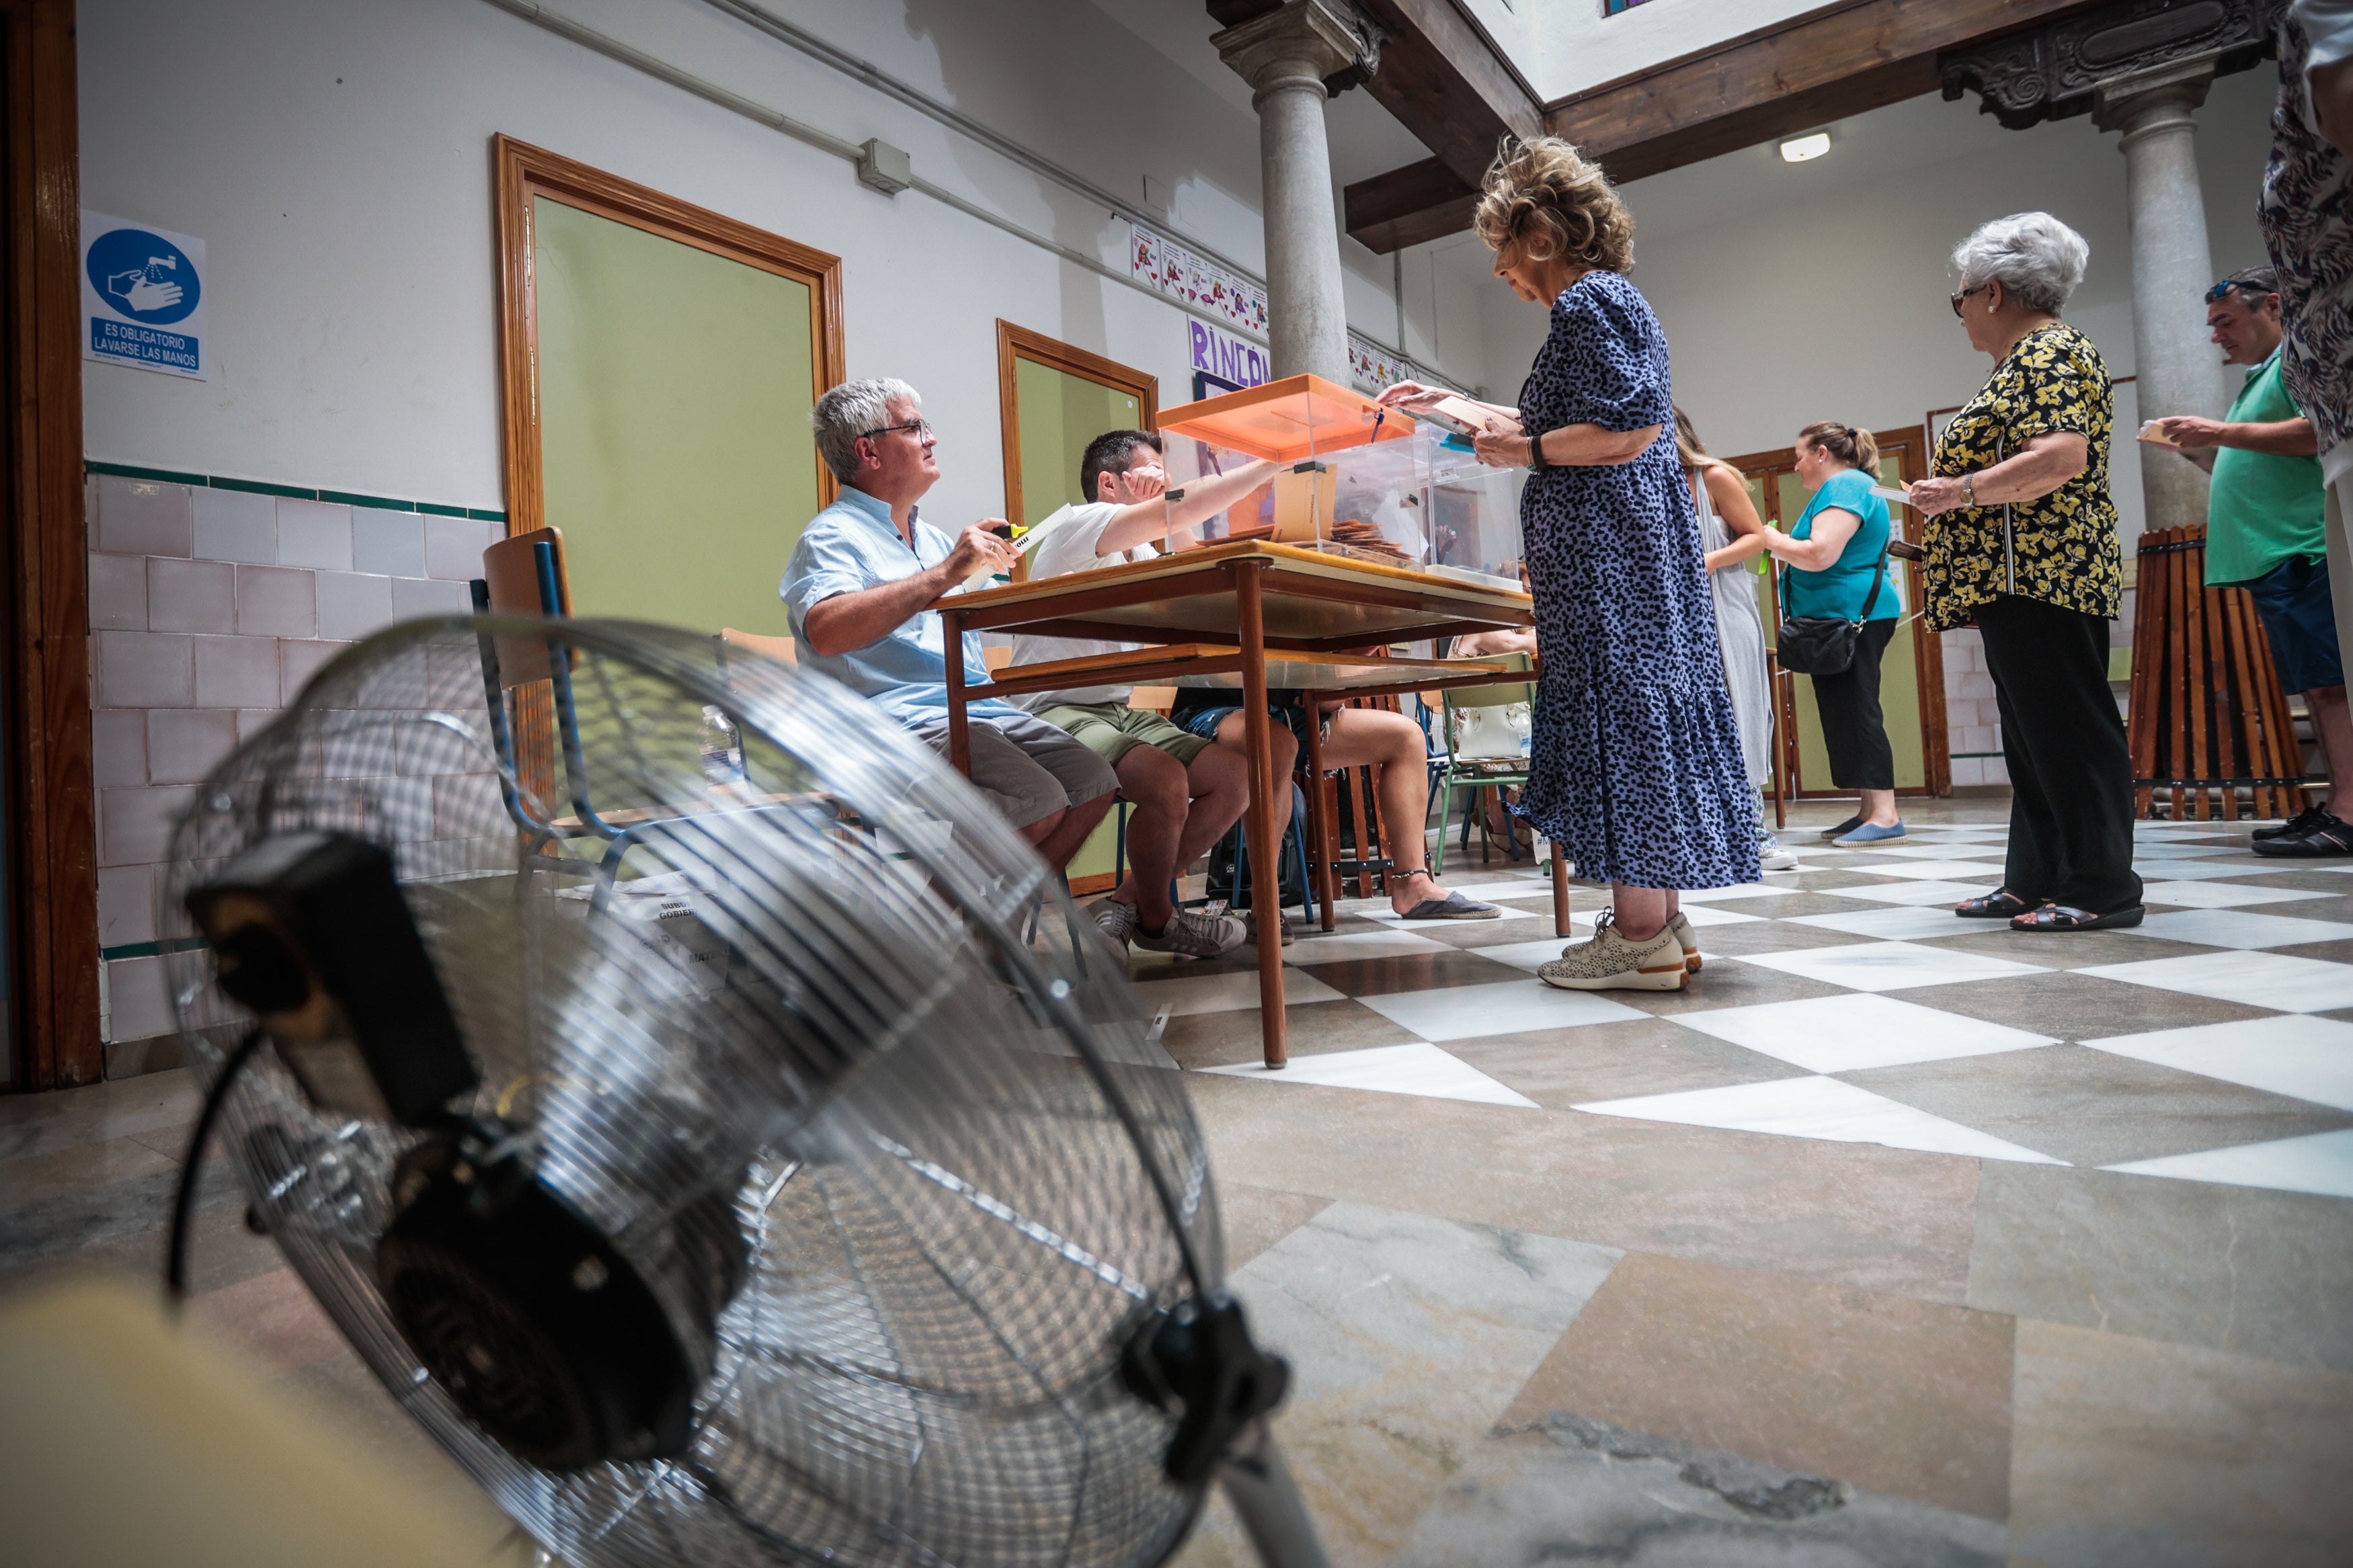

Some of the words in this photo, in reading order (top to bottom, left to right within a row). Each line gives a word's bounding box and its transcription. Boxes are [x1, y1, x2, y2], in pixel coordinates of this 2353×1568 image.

[106, 323, 118, 337] ES
[120, 327, 185, 350] OBLIGATORIO
[95, 337, 141, 356] LAVARSE
[142, 345, 161, 360] LAS
[163, 349, 196, 367] MANOS
